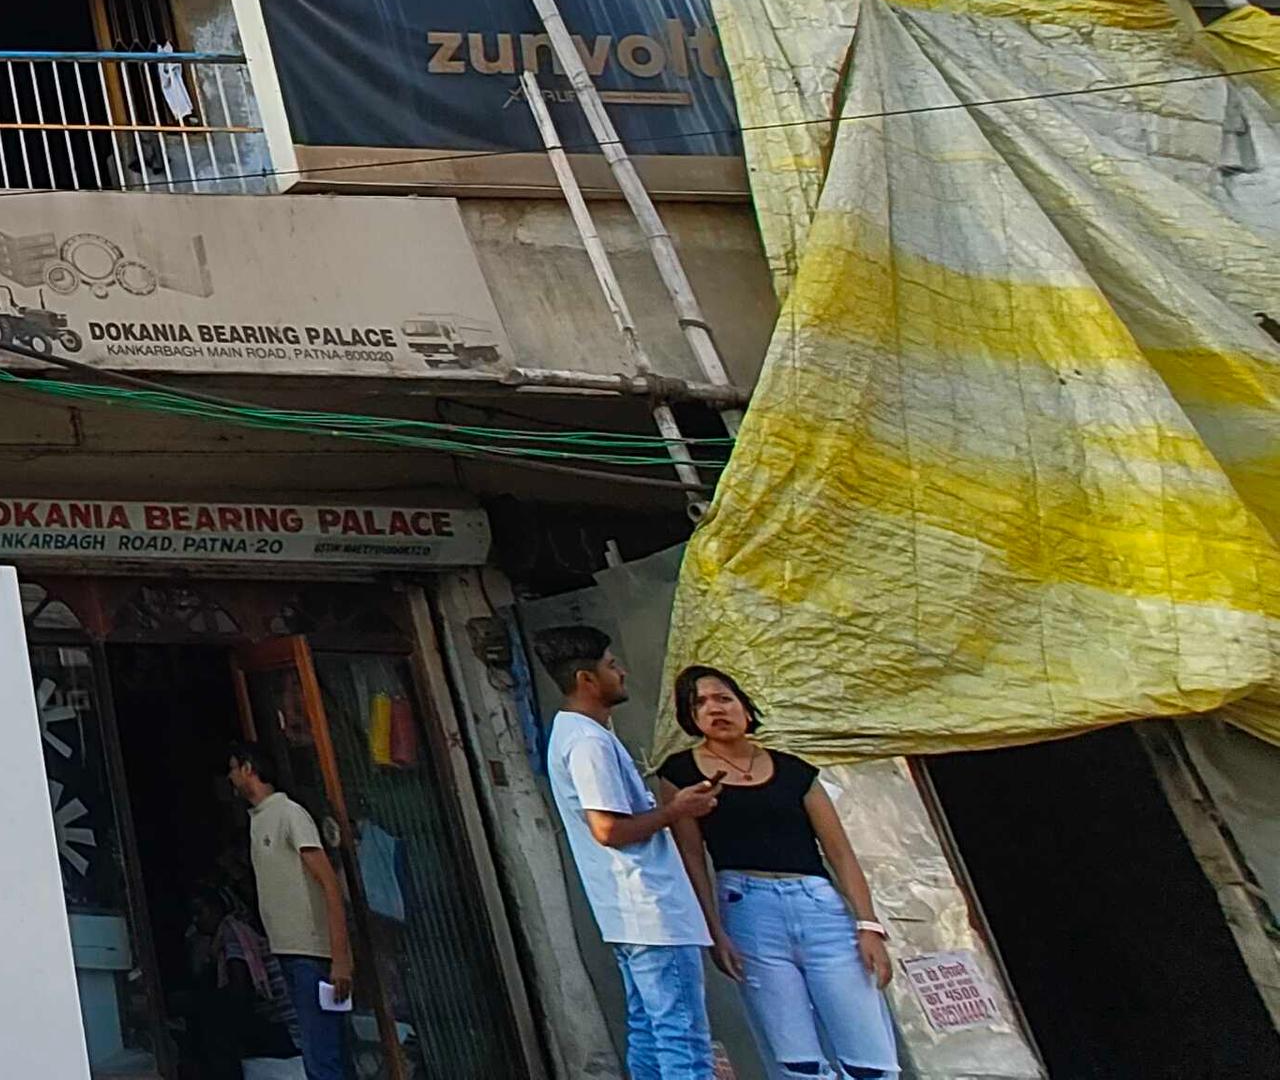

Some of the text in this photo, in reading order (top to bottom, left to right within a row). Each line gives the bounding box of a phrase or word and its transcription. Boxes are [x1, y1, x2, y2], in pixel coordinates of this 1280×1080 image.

[88, 322, 397, 348] DOKANIA BEARING PALACE
[107, 344, 204, 358] KANKARBAGH
[208, 346, 242, 358] MAIN
[143, 504, 303, 534] BEARING
[317, 509, 455, 537] PALACE
[182, 535, 284, 555] PATNA-20
